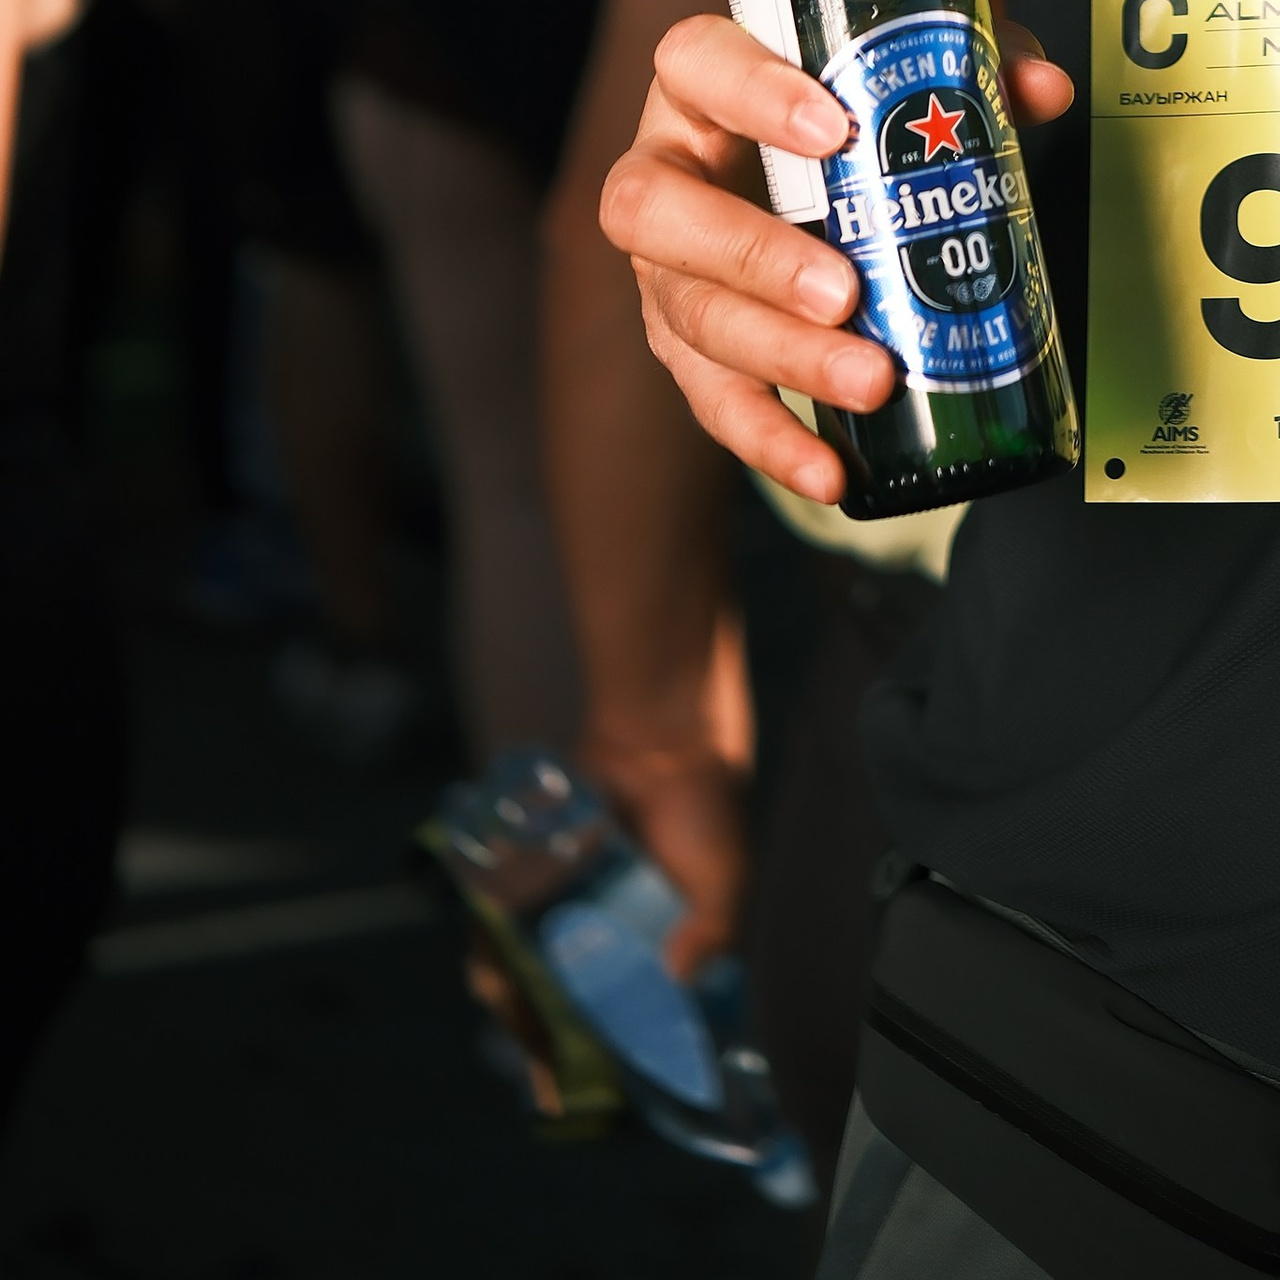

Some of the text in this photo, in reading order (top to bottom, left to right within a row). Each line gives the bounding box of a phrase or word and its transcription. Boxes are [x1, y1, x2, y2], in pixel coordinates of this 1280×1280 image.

[942, 49, 972, 80] 0.0
[976, 65, 1009, 130] BEER
[1119, 91, 1228, 106] БАУЫРЖАН
[832, 168, 1029, 244] Heineken
[940, 231, 990, 277] 0.0
[1151, 426, 1199, 441] AIMS
